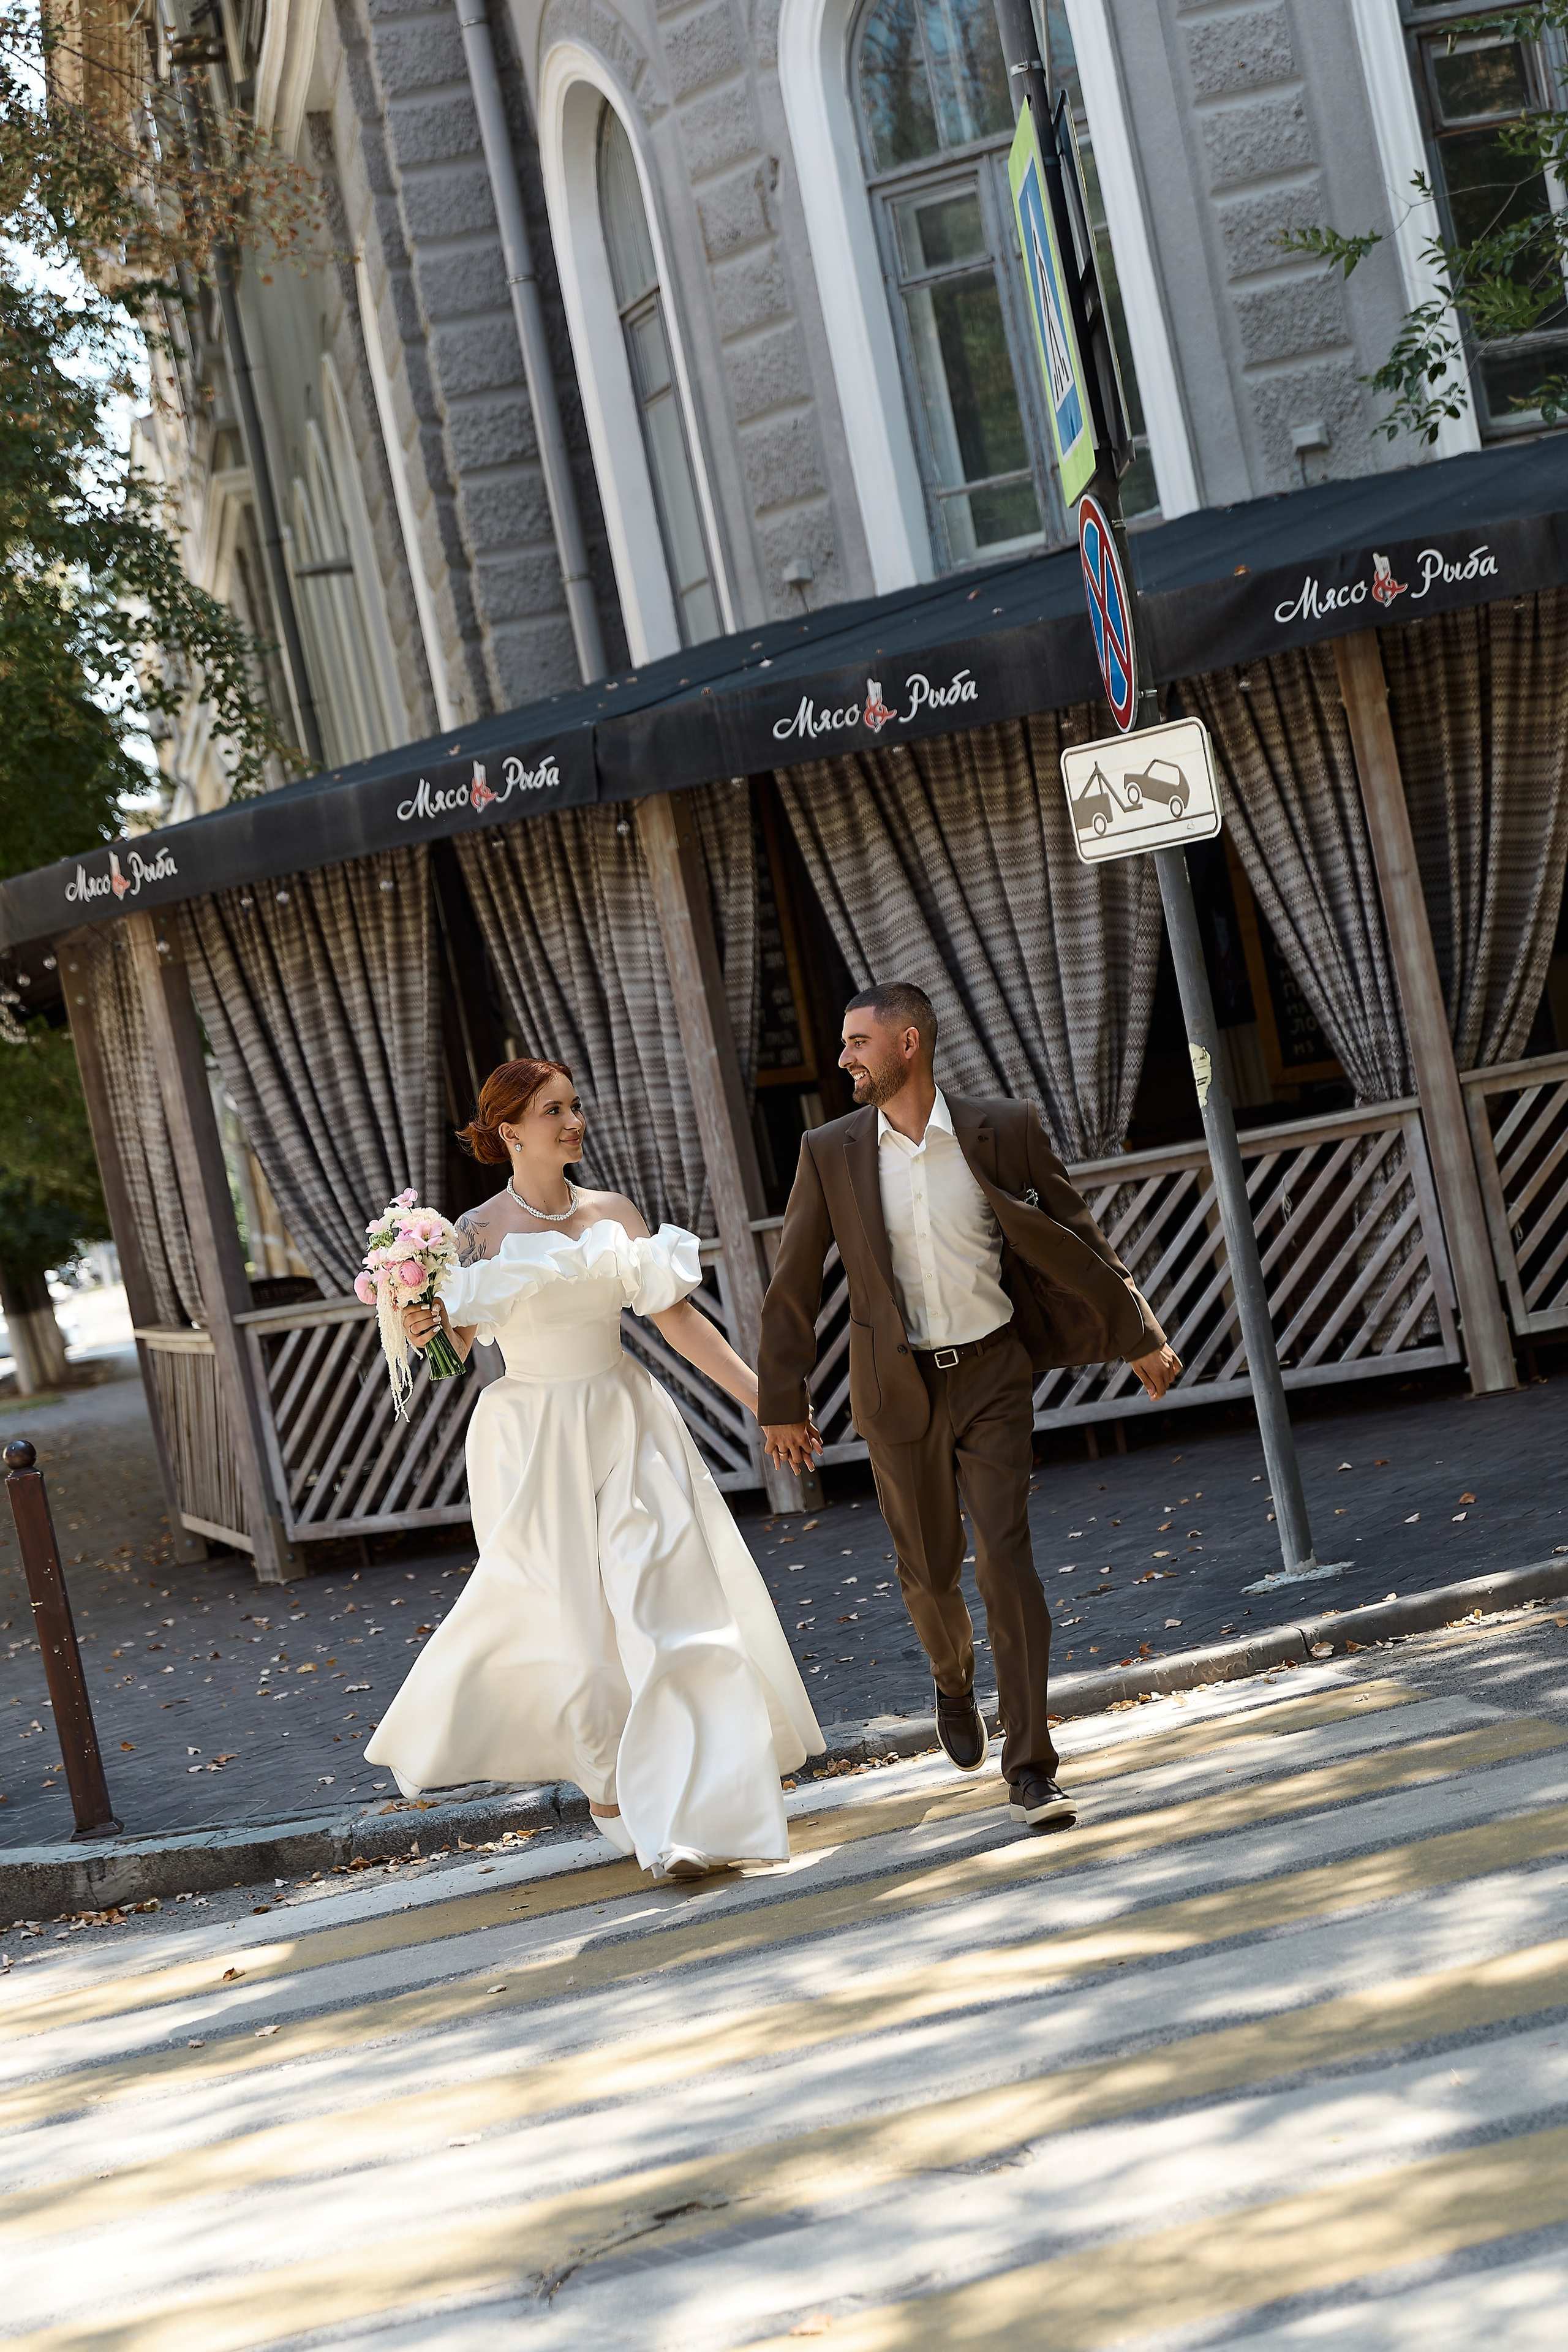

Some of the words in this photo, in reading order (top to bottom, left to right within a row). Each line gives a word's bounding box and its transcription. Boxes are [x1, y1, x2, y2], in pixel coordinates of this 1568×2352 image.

[1273, 576, 1368, 624] Мясо
[1411, 545, 1499, 599] Рыба
[772, 695, 862, 739] Мясо
[898, 669, 979, 723] Рыба
[396, 777, 469, 821] Мясо
[495, 755, 560, 803] Рыба
[64, 863, 111, 902] Мясо
[127, 846, 179, 895] Рыба
